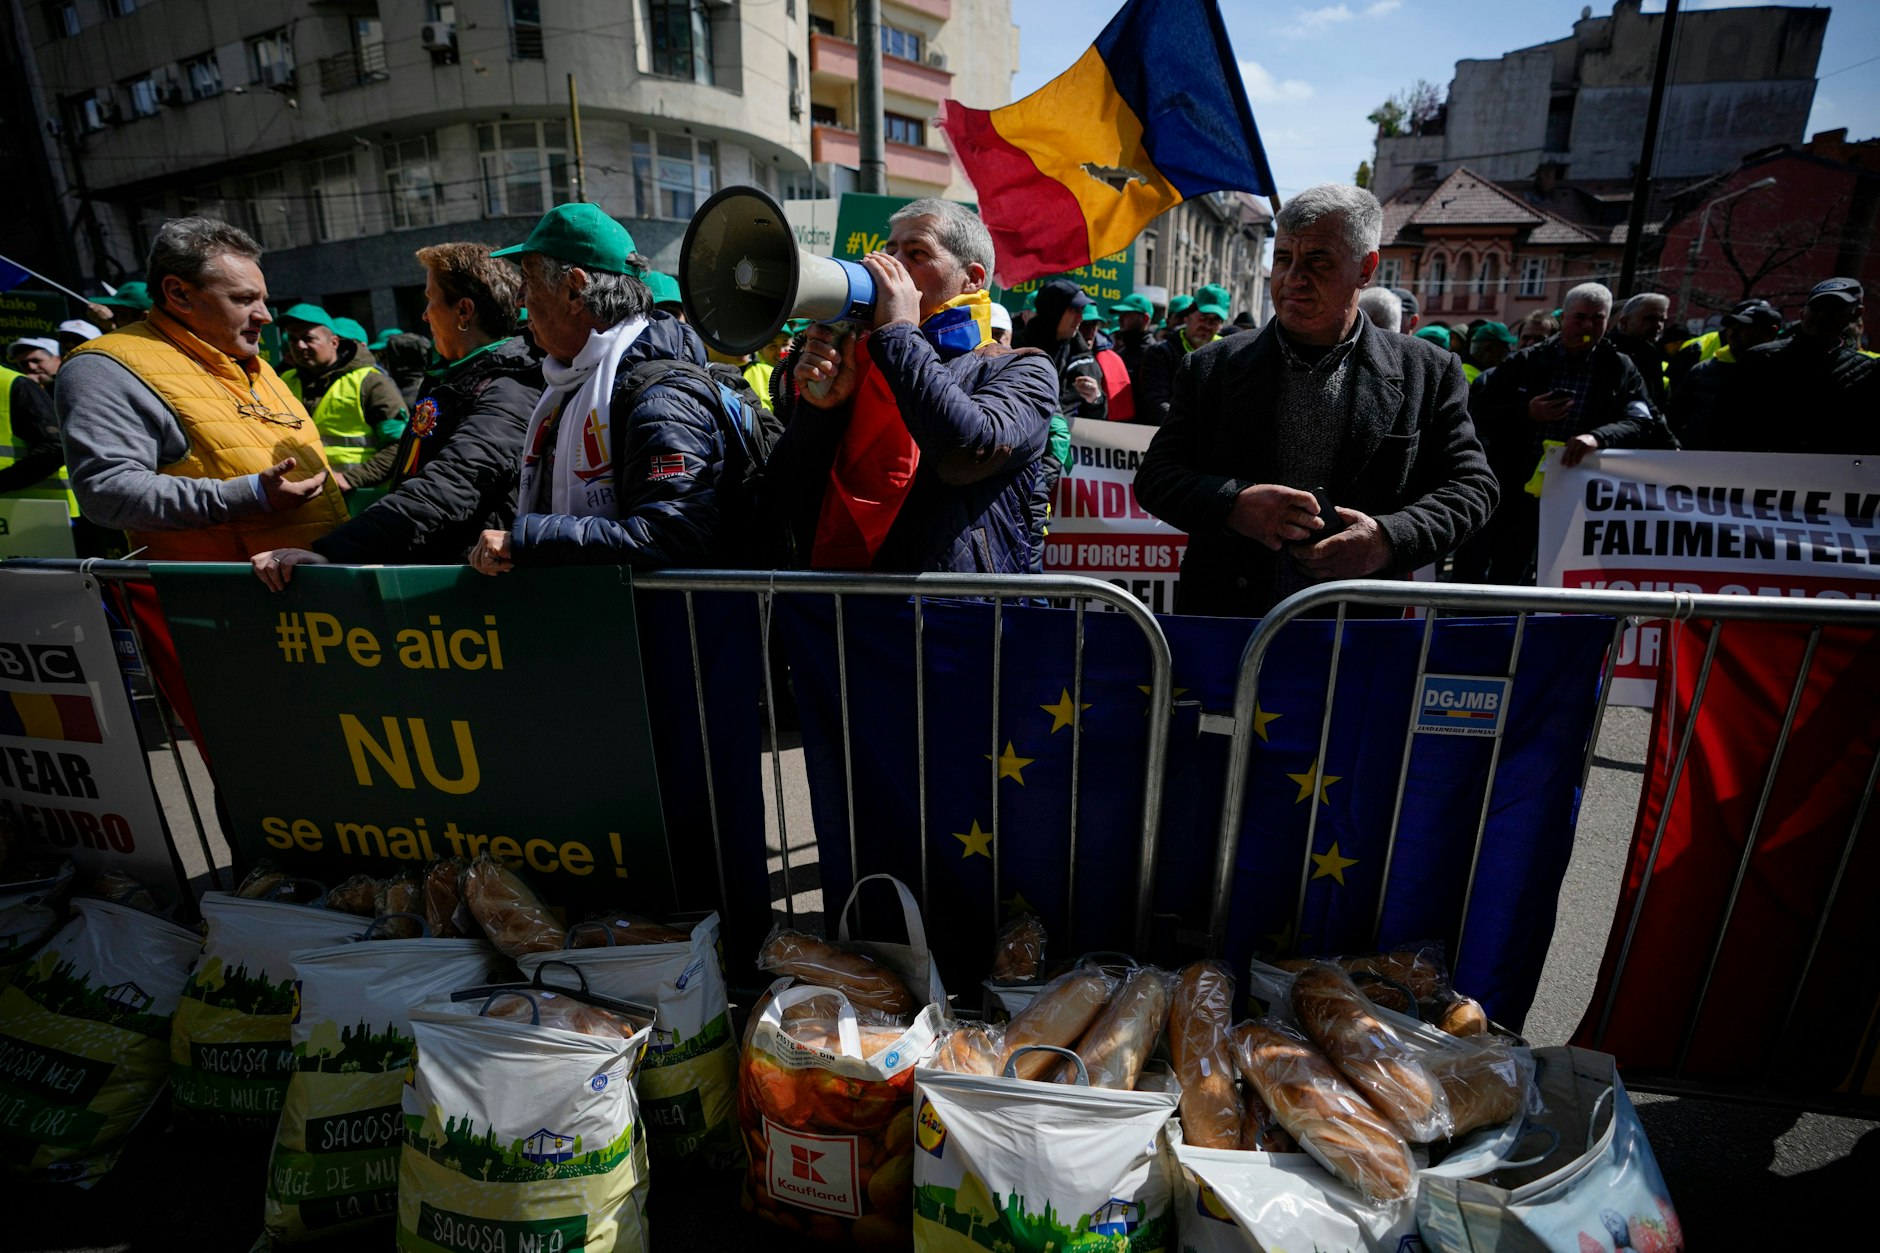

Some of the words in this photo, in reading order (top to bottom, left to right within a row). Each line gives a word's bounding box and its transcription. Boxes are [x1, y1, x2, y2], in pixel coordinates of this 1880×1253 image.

[1091, 264, 1118, 281] but
[1101, 287, 1121, 300] us
[1585, 478, 1832, 527] CALCULELE
[1845, 492, 1880, 529] V
[1042, 544, 1073, 567] OU
[1076, 544, 1140, 568] FORCE
[1144, 545, 1172, 568] US
[275, 611, 382, 668] #Pe
[396, 614, 504, 670] aici
[1424, 689, 1499, 711] DGJMB
[339, 713, 481, 795] NU
[22, 803, 135, 854] EURO
[262, 816, 323, 852] se
[335, 817, 434, 862] mai
[444, 822, 595, 877] trece
[326, 1166, 357, 1193] DE
[778, 1177, 847, 1203] Kaufland
